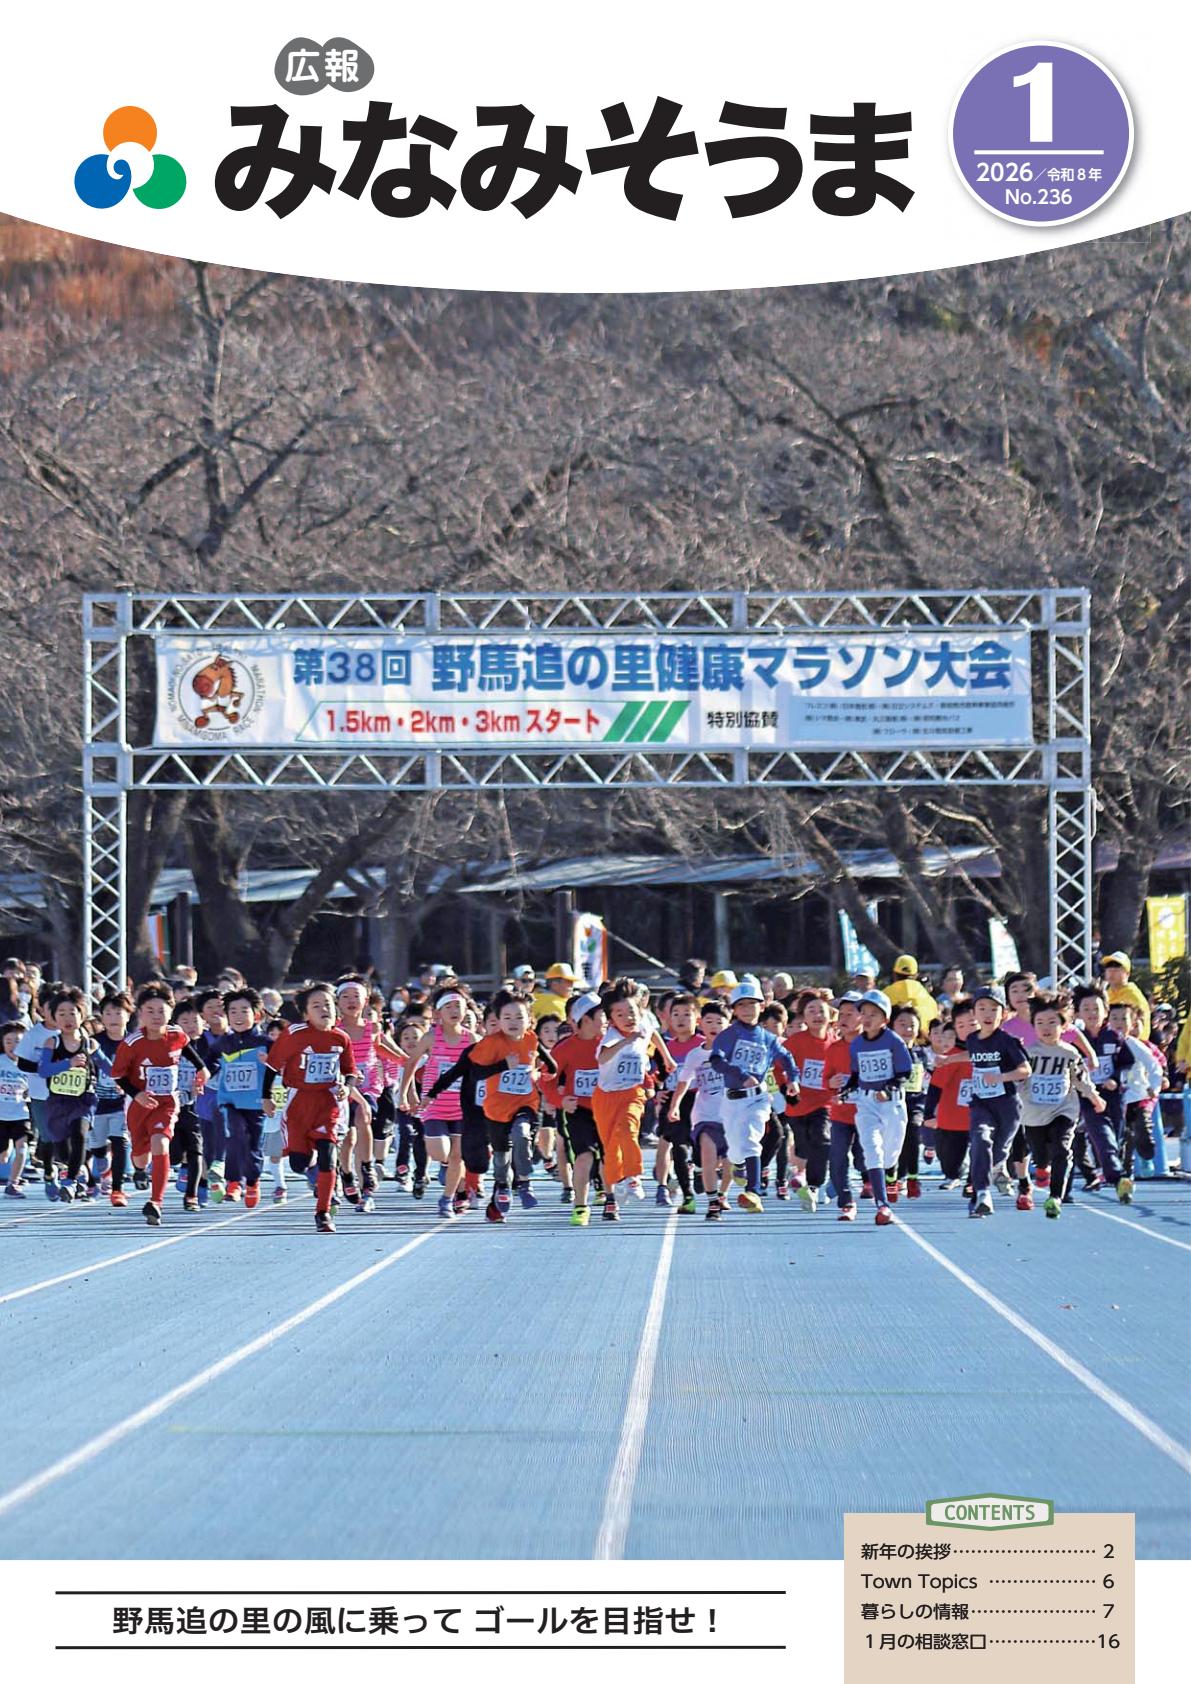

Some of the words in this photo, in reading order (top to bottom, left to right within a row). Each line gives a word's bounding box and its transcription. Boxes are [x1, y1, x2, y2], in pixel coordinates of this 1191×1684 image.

[293, 648, 413, 686] 第38回
[431, 641, 1012, 693] 野馬追の里健康マラソン大会
[527, 708, 601, 734] スタート
[707, 711, 779, 730] 特別協賛
[861, 1058, 888, 1073] 6138
[225, 1069, 252, 1083] 6107
[1031, 1082, 1062, 1096] 6125
